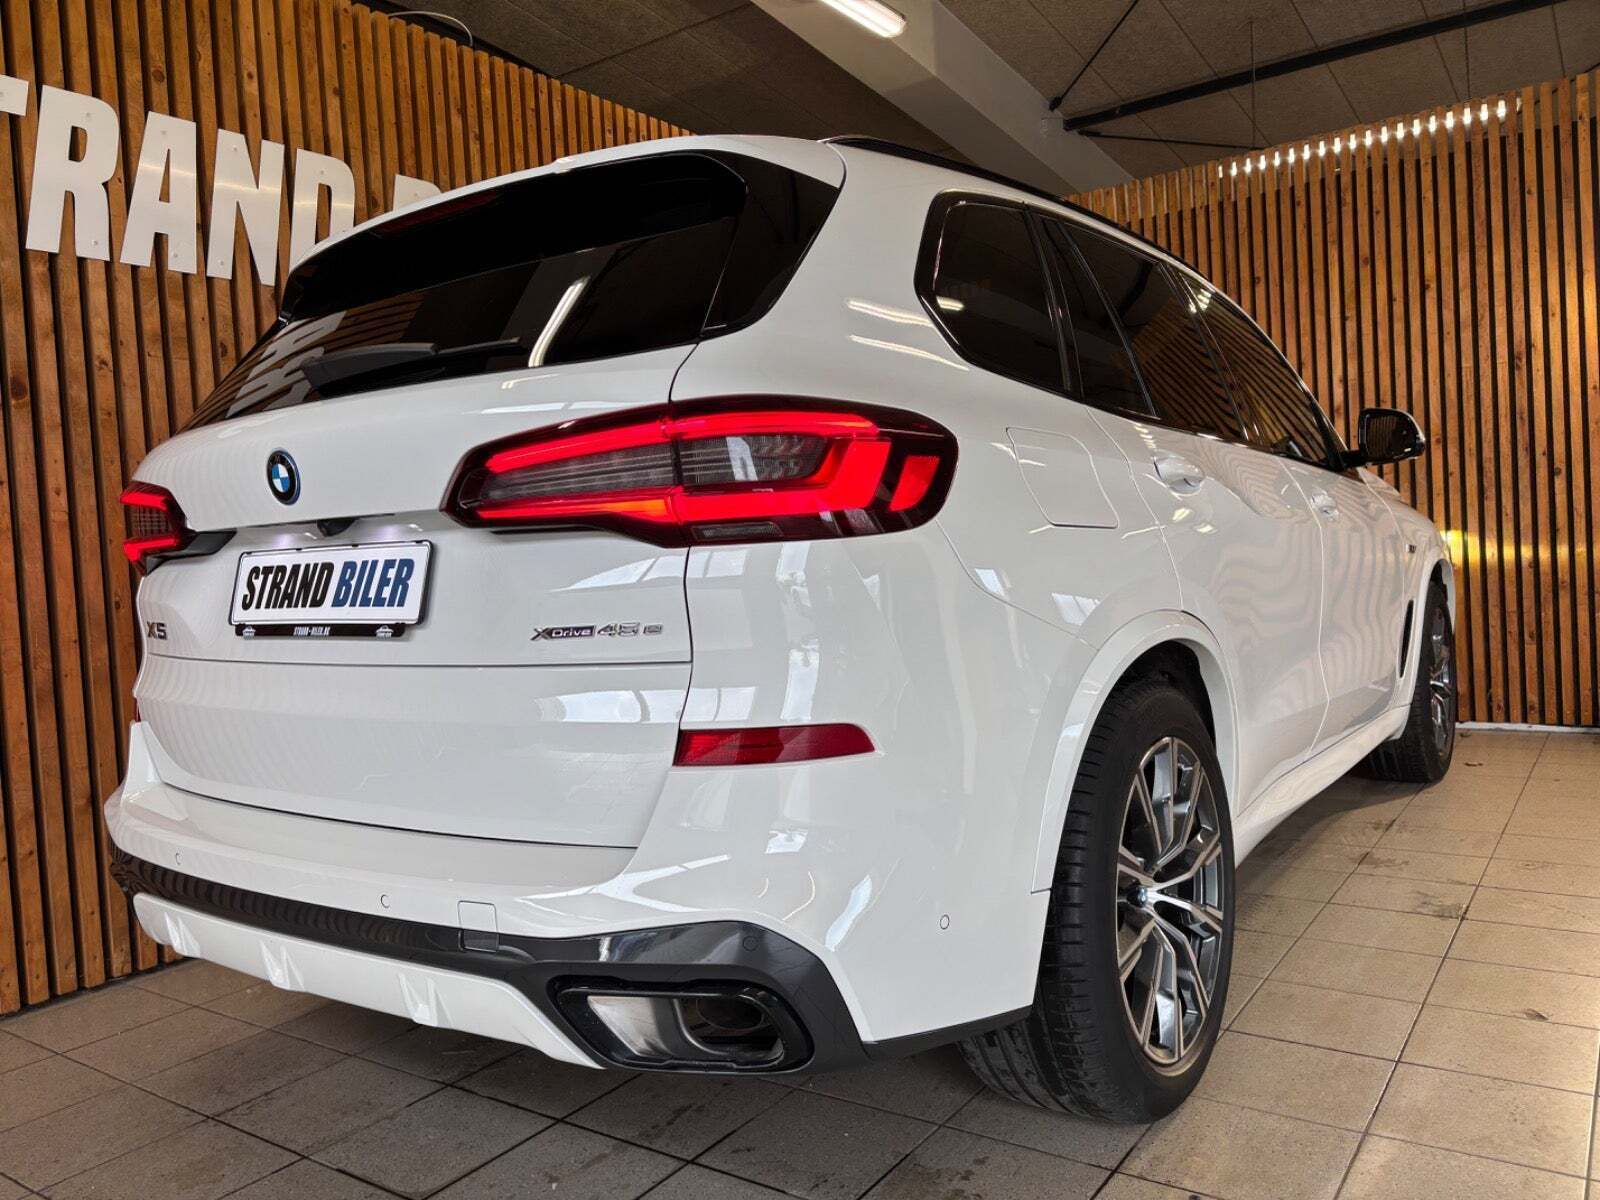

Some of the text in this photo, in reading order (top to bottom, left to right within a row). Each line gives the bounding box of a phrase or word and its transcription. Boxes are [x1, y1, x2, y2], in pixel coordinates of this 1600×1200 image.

[241, 558, 416, 611] STRAND BILER
[146, 620, 168, 640] X5
